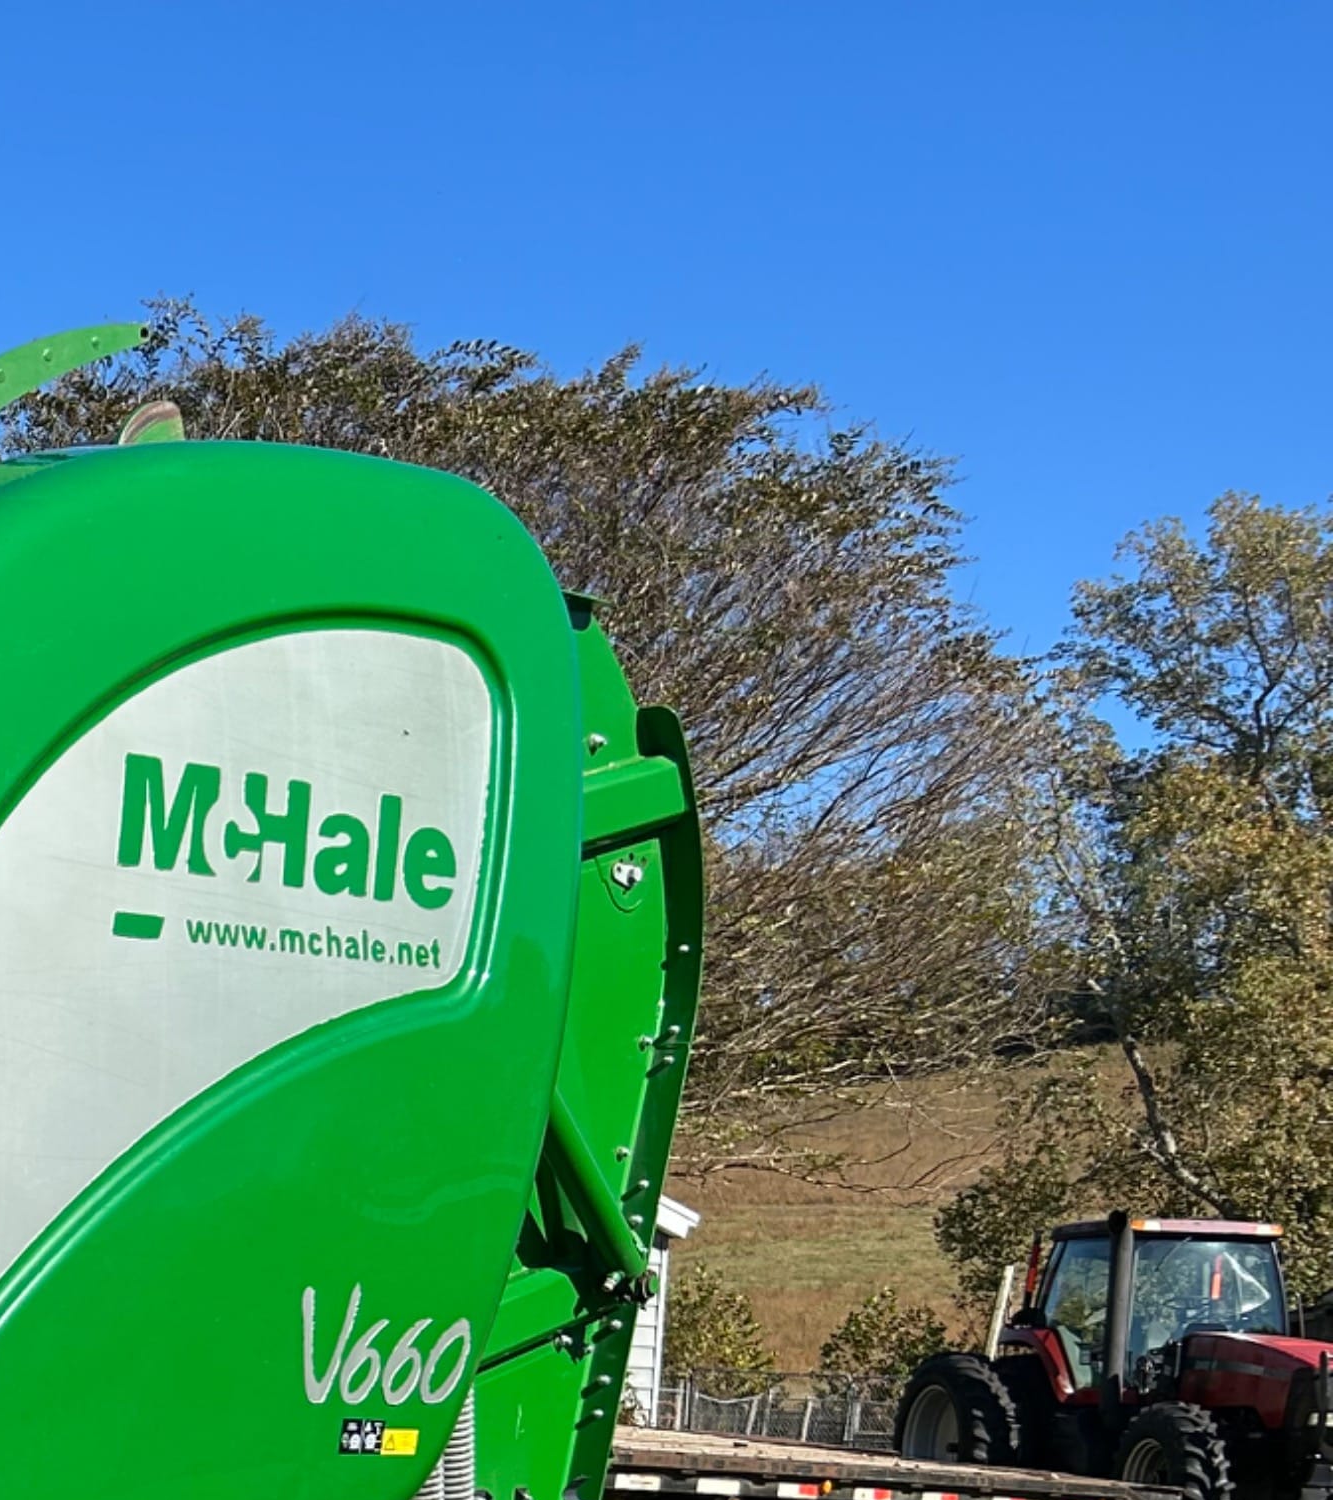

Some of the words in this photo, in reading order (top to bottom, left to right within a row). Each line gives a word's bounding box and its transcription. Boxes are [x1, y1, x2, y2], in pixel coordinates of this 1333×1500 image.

[117, 752, 457, 910] McHale
[185, 918, 441, 969] www.mchale.net
[301, 1282, 471, 1406] V660
